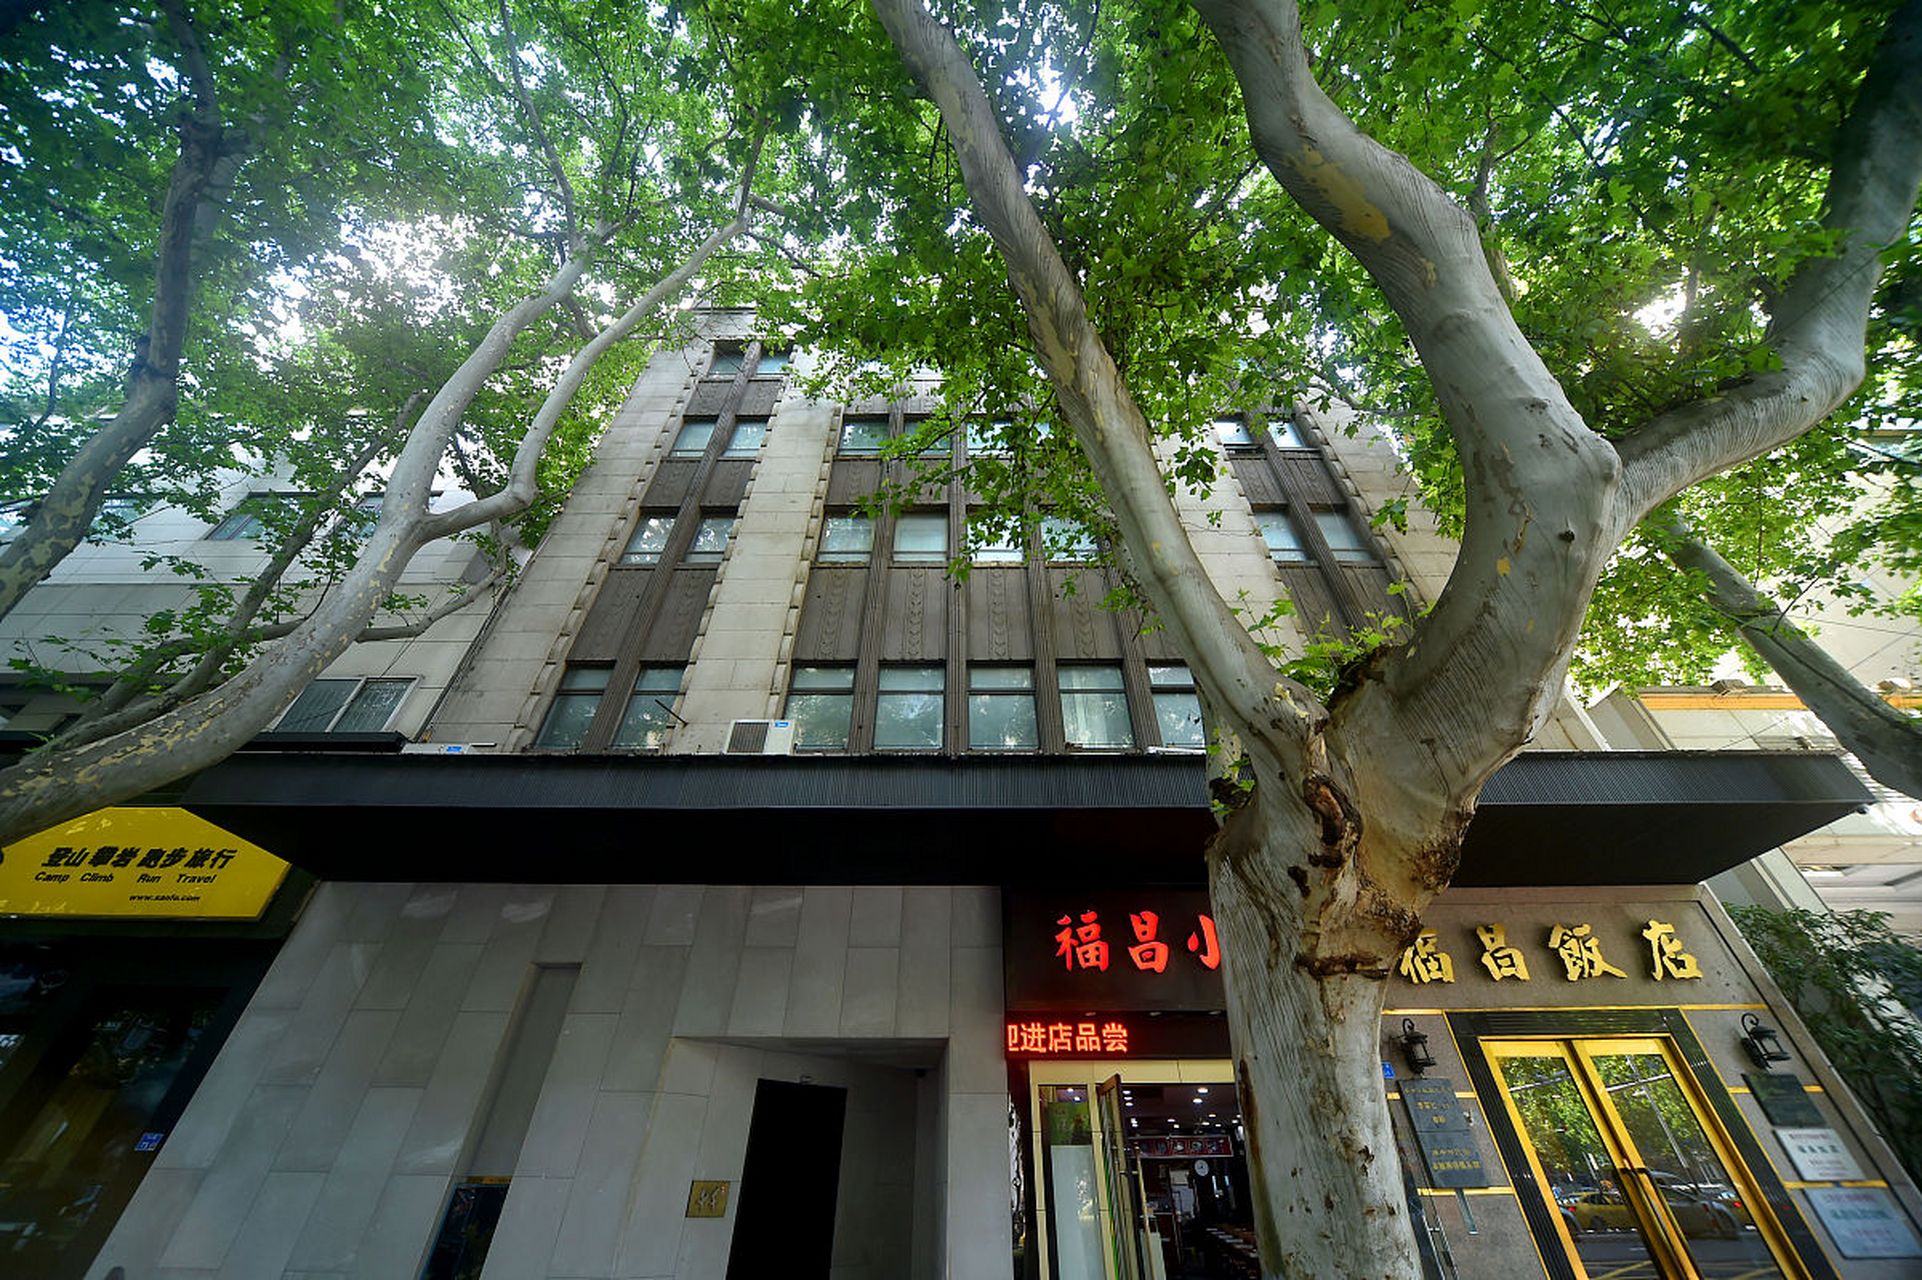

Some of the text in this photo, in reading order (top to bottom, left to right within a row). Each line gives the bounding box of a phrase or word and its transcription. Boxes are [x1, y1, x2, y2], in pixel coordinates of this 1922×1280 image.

[41, 846, 238, 869] 登山 攀岩 跑步 旅行
[34, 871, 217, 883] Camp Climb Run Travel
